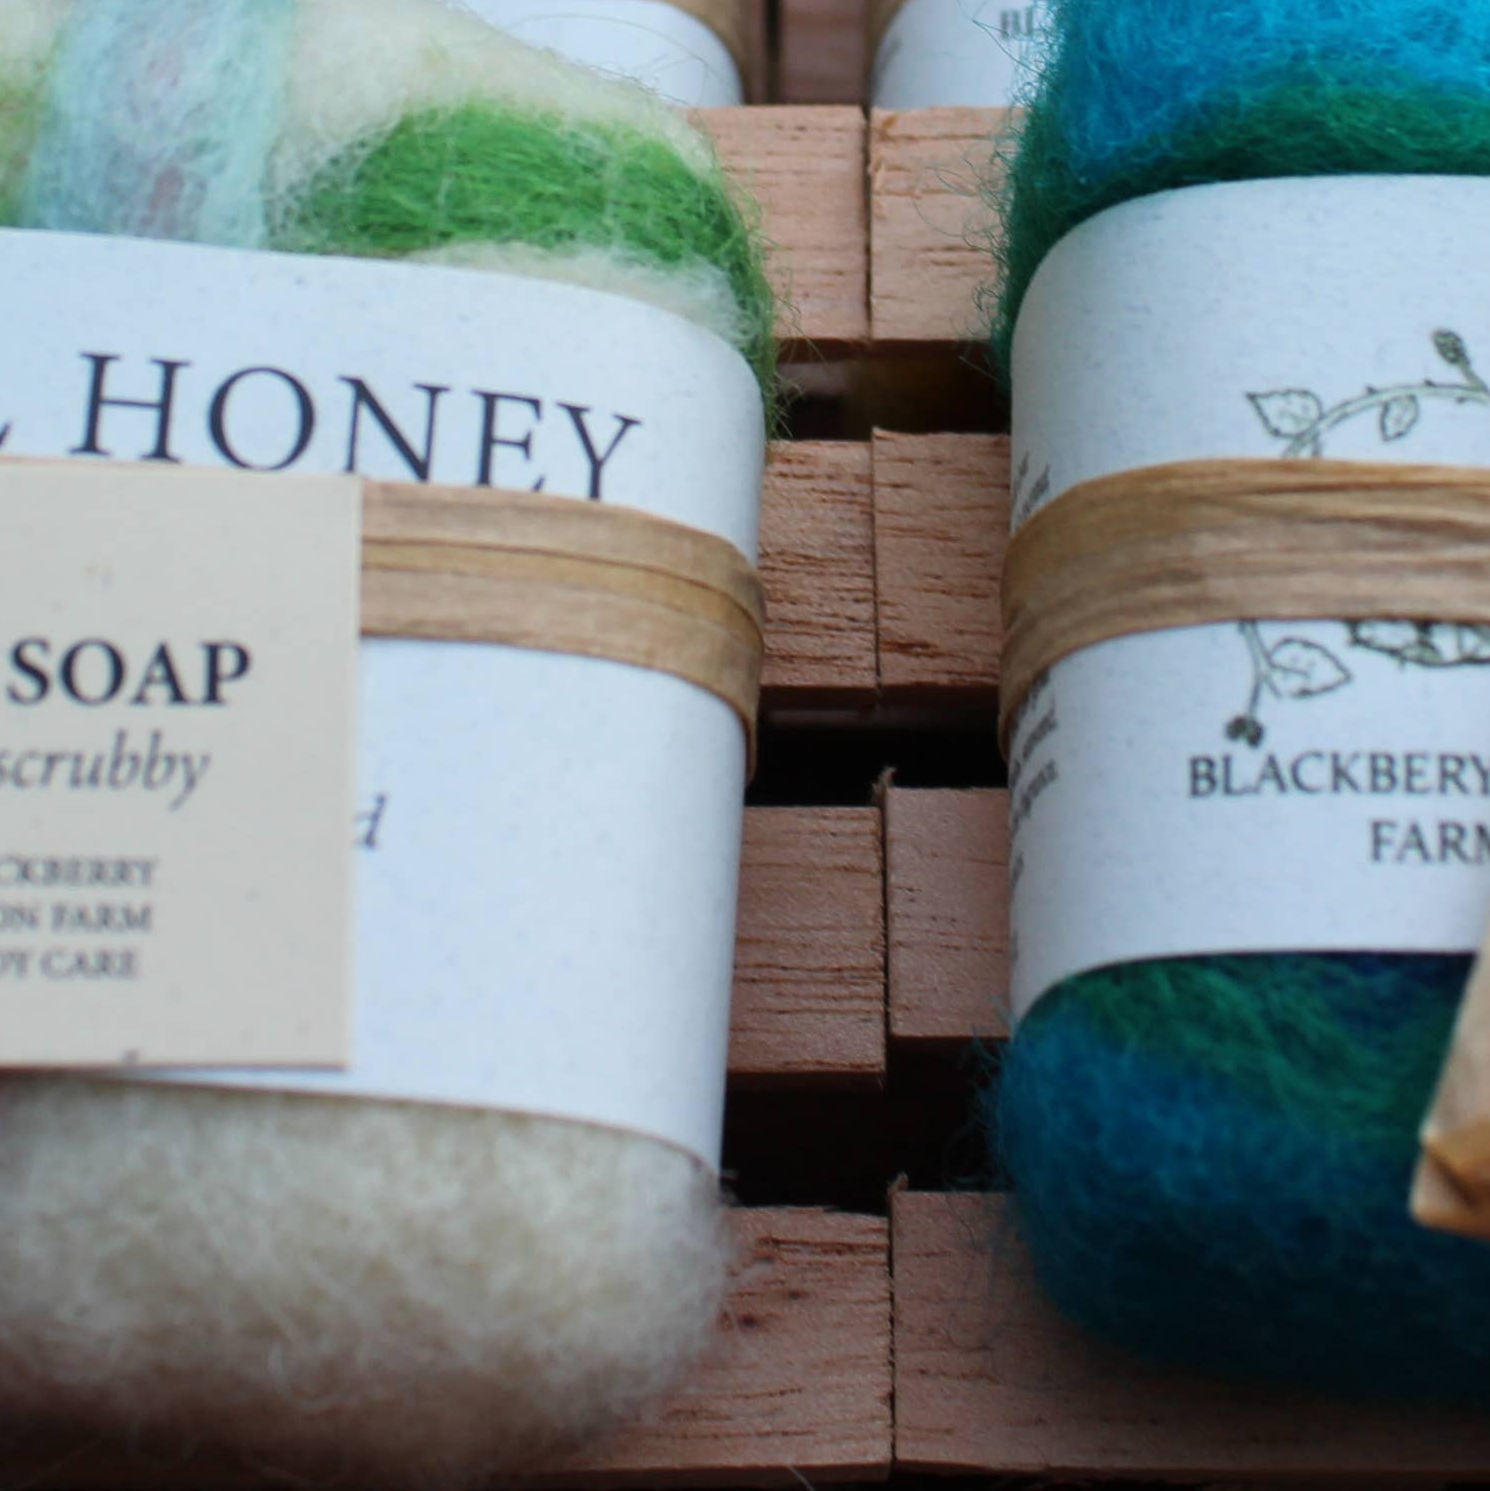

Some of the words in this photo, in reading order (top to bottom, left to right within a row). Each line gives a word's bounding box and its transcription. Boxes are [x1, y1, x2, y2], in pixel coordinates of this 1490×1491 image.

[73, 350, 643, 502] HONEY
[6, 637, 252, 708] SOAP
[50, 901, 153, 933] FARM
[38, 947, 139, 981] CARE
